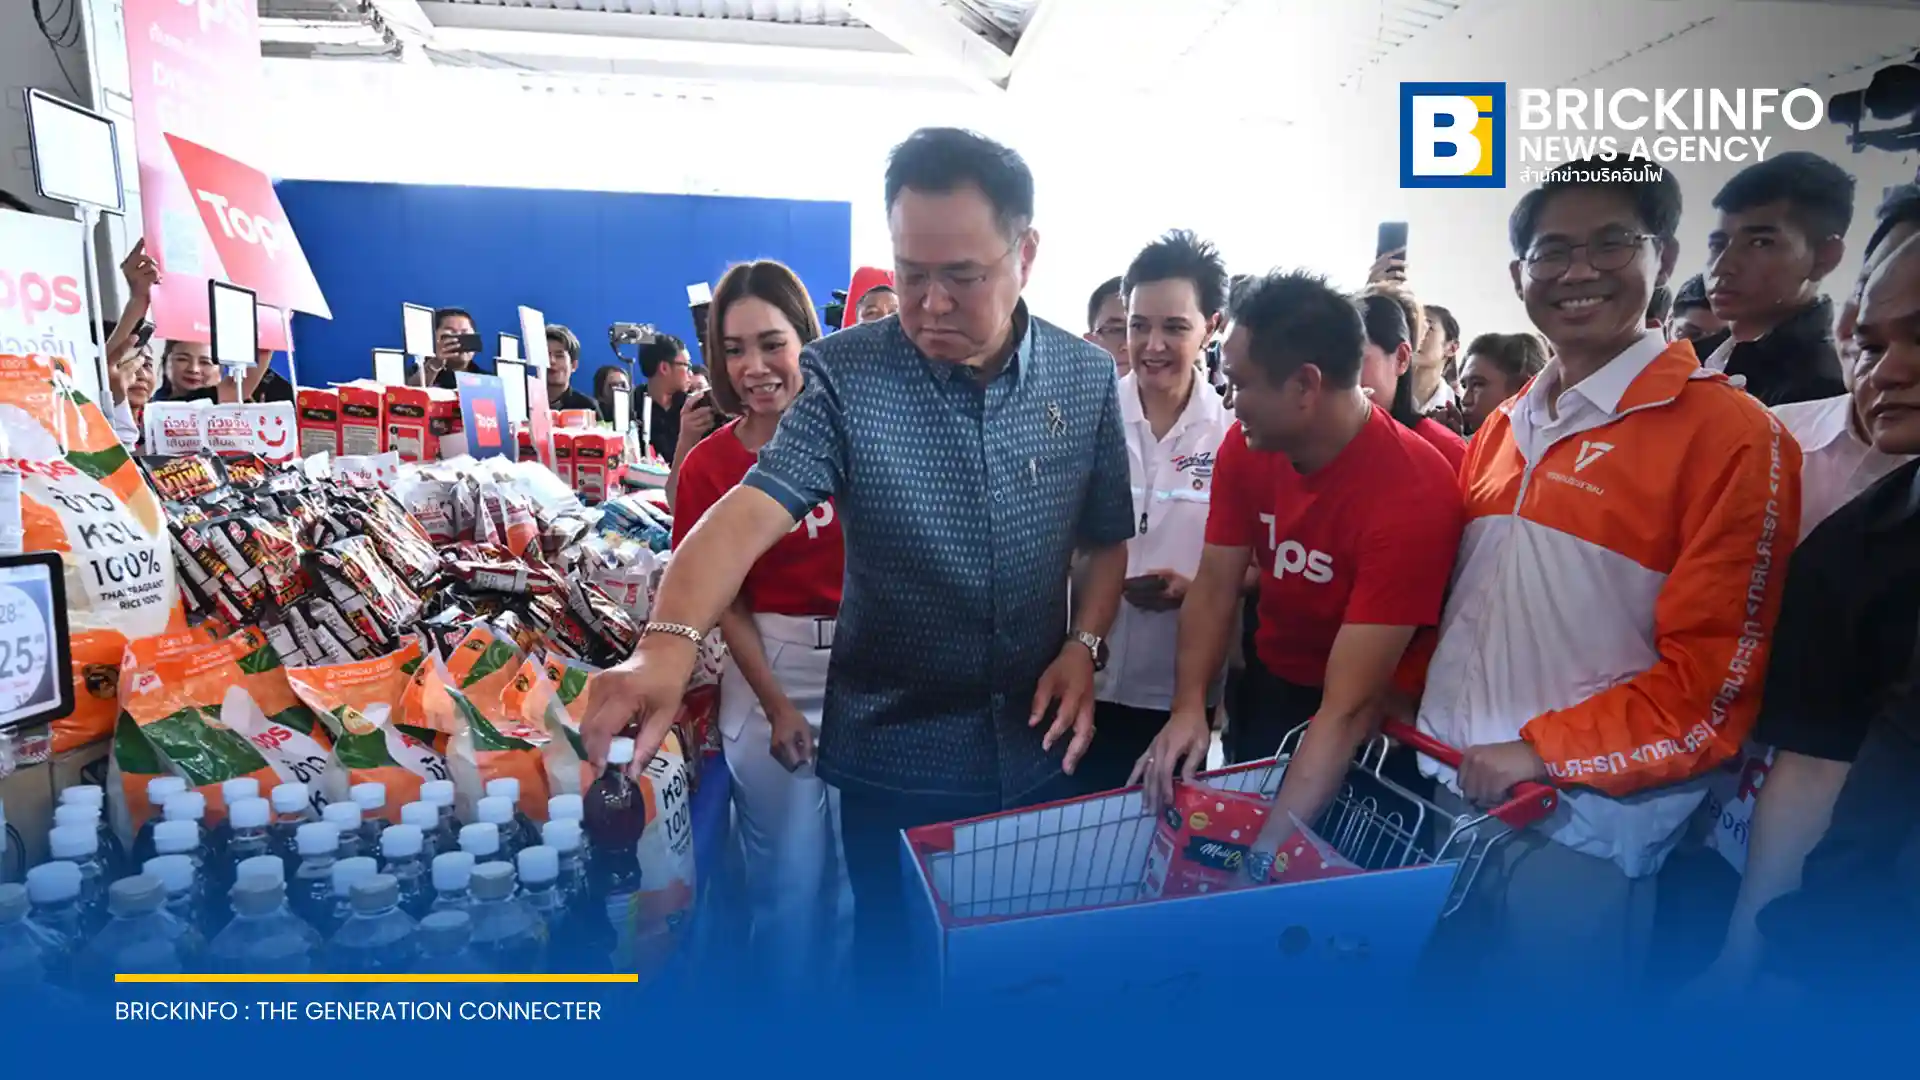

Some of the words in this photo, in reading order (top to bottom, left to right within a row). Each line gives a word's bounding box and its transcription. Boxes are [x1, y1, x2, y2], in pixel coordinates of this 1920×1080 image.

[197, 189, 285, 260] Top
[0, 269, 81, 325] ops
[90, 548, 161, 586] 100%
[1259, 512, 1334, 583] Tps
[119, 597, 141, 610] RICE
[665, 802, 688, 840] 100
